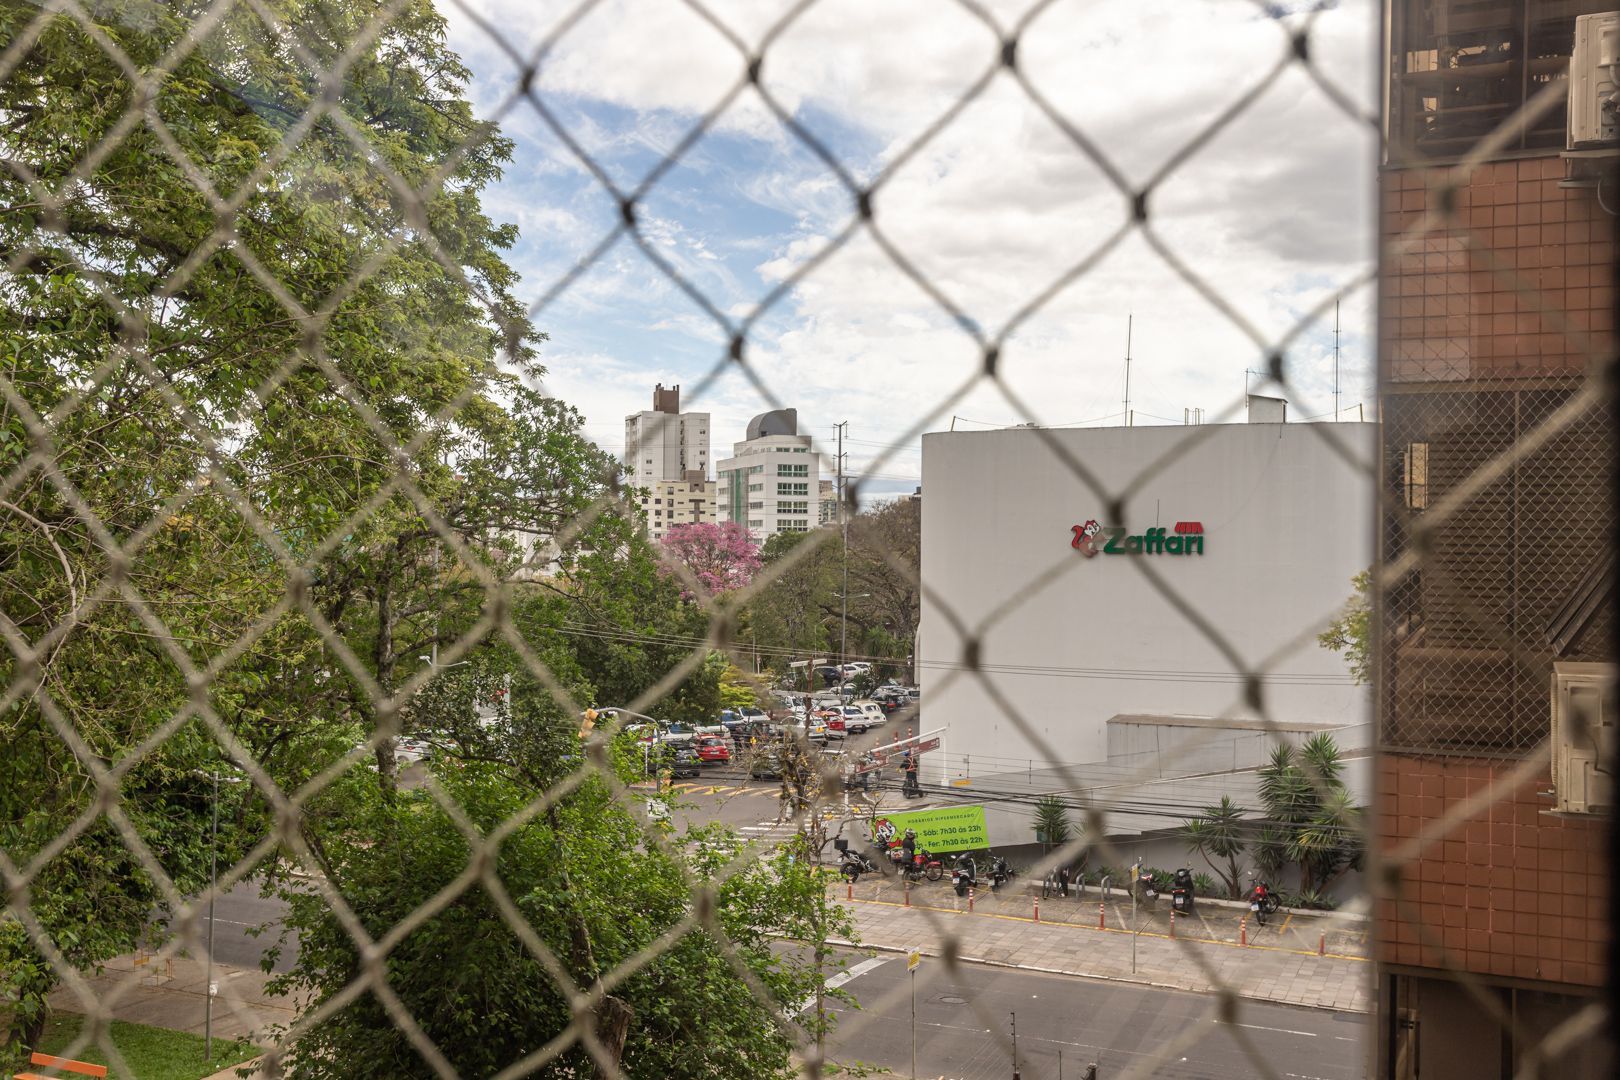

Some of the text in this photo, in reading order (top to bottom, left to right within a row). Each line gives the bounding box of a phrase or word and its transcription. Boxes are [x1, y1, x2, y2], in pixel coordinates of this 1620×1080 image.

[1103, 527, 1204, 555] Zaffari
[940, 827, 957, 835] 7h30
[942, 838, 959, 846] 7h30
[969, 836, 983, 844] 22h
